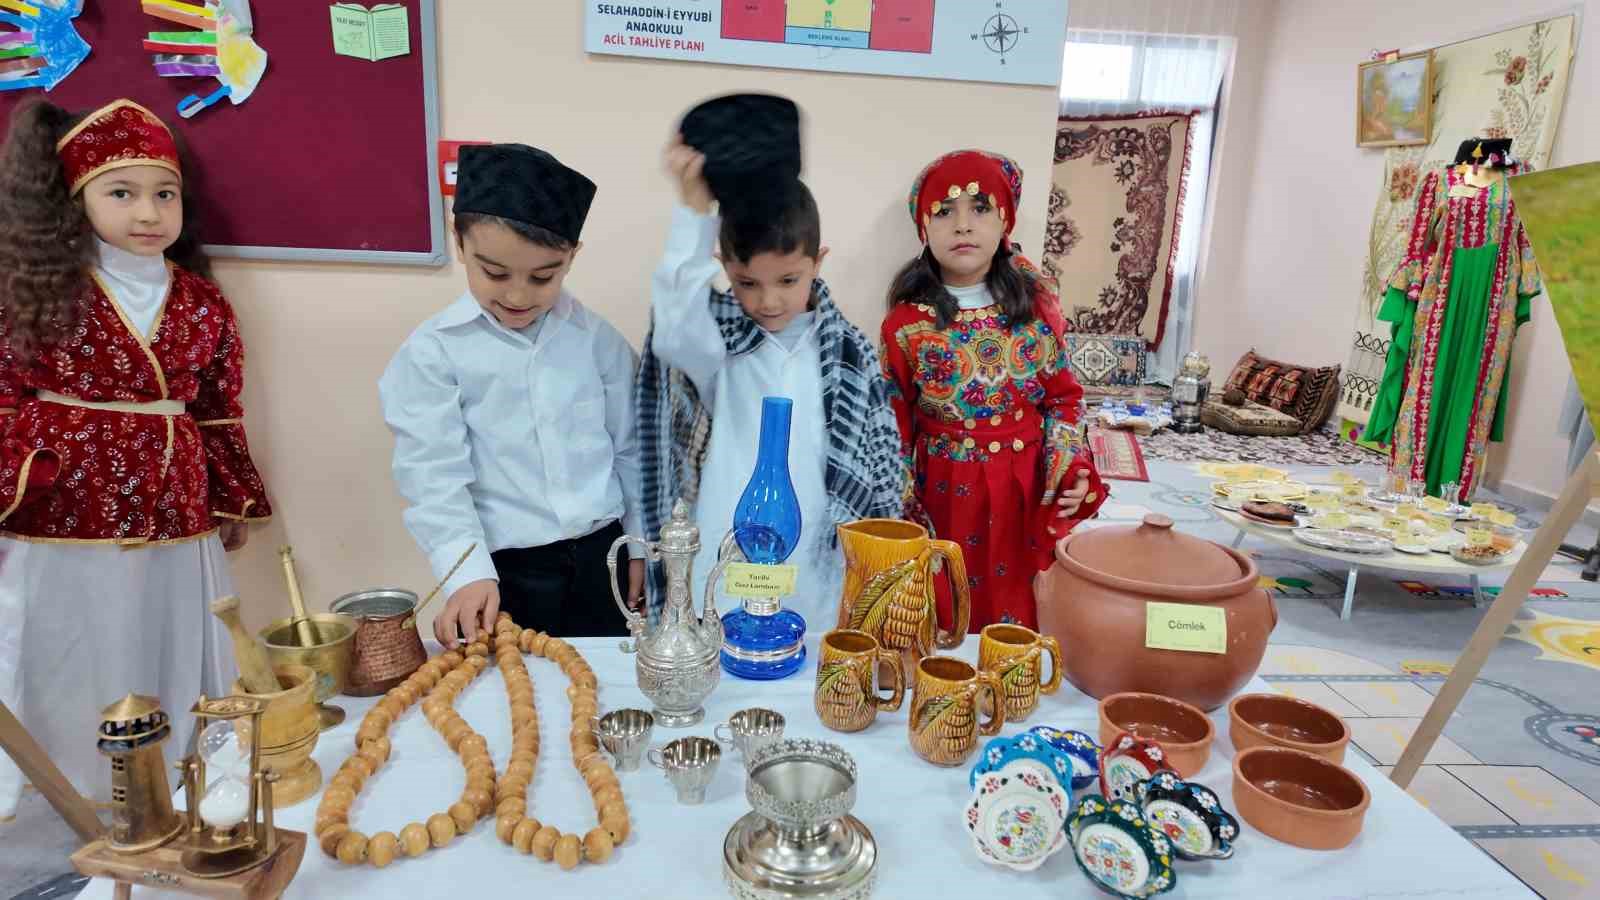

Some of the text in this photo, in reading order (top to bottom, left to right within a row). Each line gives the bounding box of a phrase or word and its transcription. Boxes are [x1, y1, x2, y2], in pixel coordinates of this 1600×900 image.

[673, 9, 712, 22] EYYUBİ
[626, 21, 683, 35] ANAOKULU
[604, 34, 705, 51] ACİL TAHLİYE PLANI
